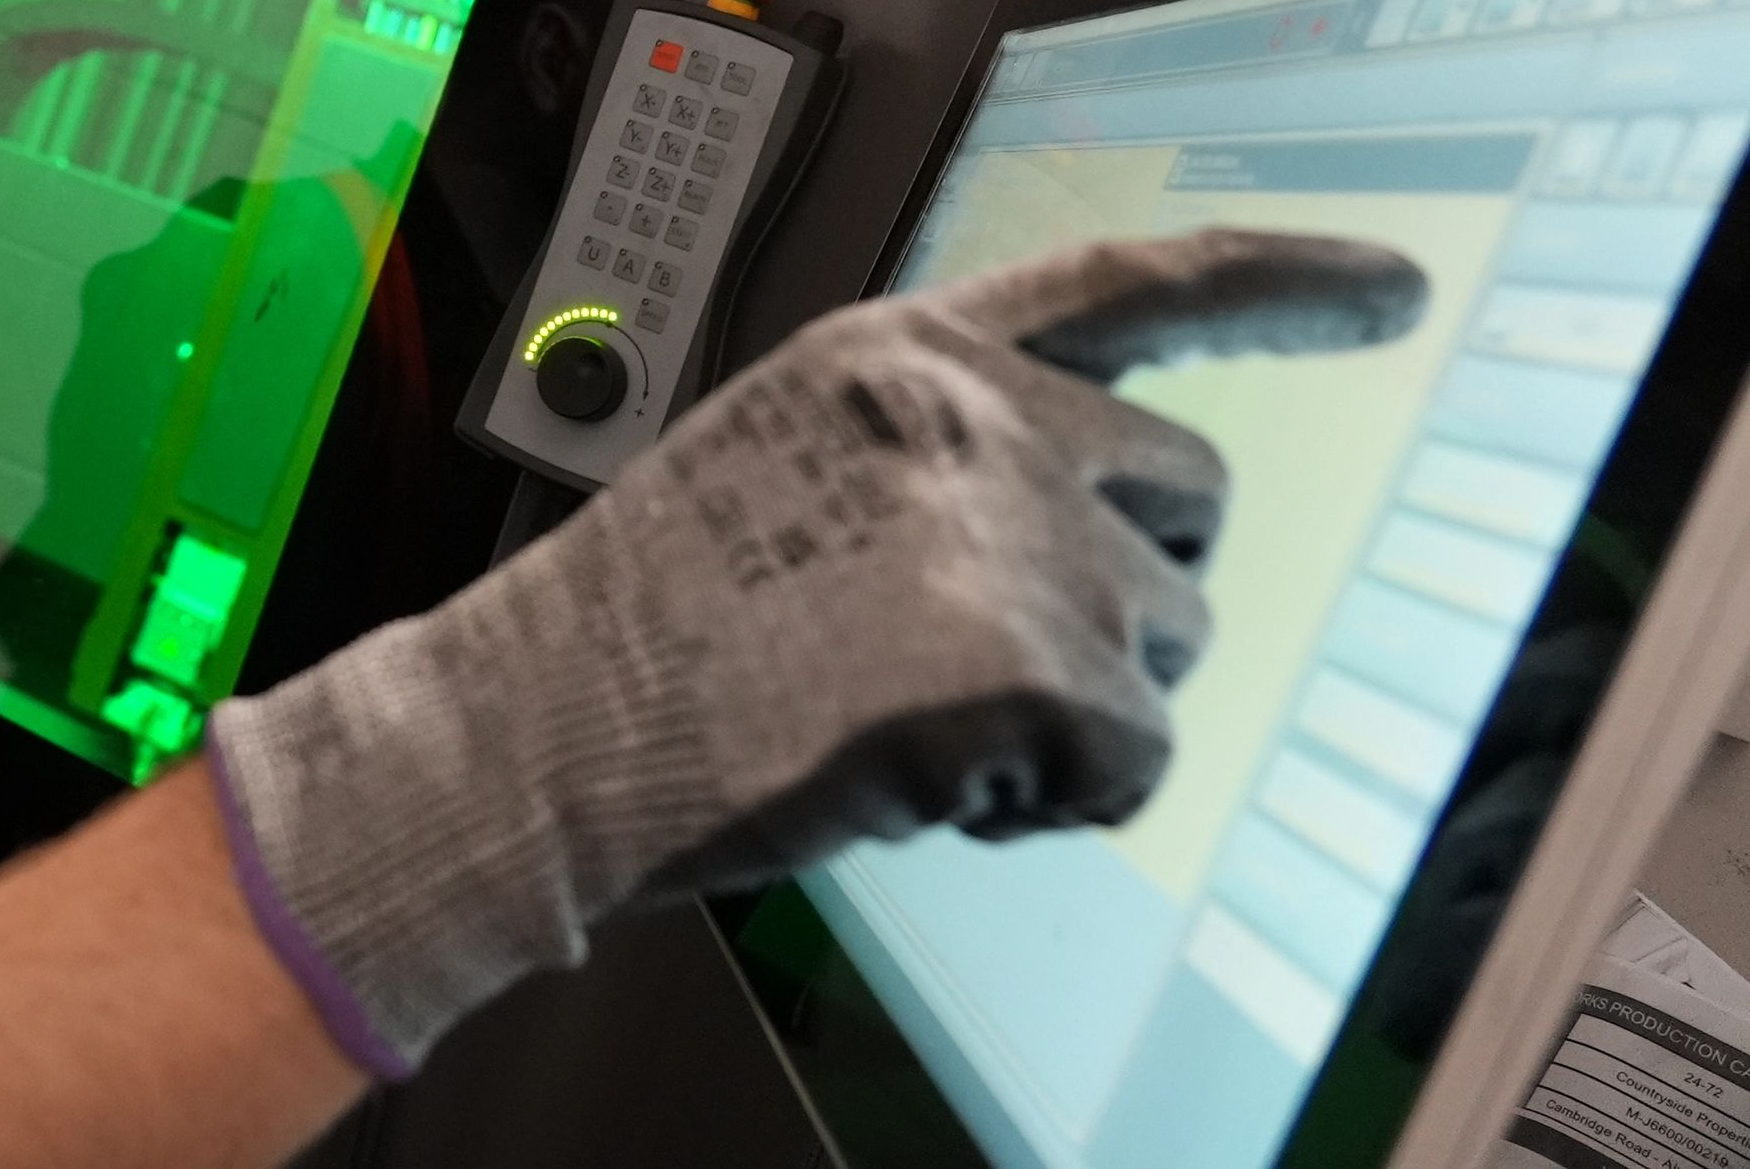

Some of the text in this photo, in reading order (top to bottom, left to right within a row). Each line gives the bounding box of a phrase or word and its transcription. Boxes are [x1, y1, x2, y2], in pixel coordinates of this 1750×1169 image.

[676, 105, 695, 120] X+
[665, 140, 682, 157] Y+
[650, 175, 670, 191] Z+
[588, 246, 600, 261] U
[622, 259, 633, 274] A
[659, 271, 671, 287] B
[1609, 1001, 1728, 1066] PRODUCTION
[1684, 1072, 1724, 1099] 24-72
[1616, 1071, 1750, 1150] Countryside Properti
[1546, 1099, 1612, 1138] Cambridge
[1615, 1132, 1652, 1159] Road
[1625, 1107, 1729, 1168] M-J6600/00219
